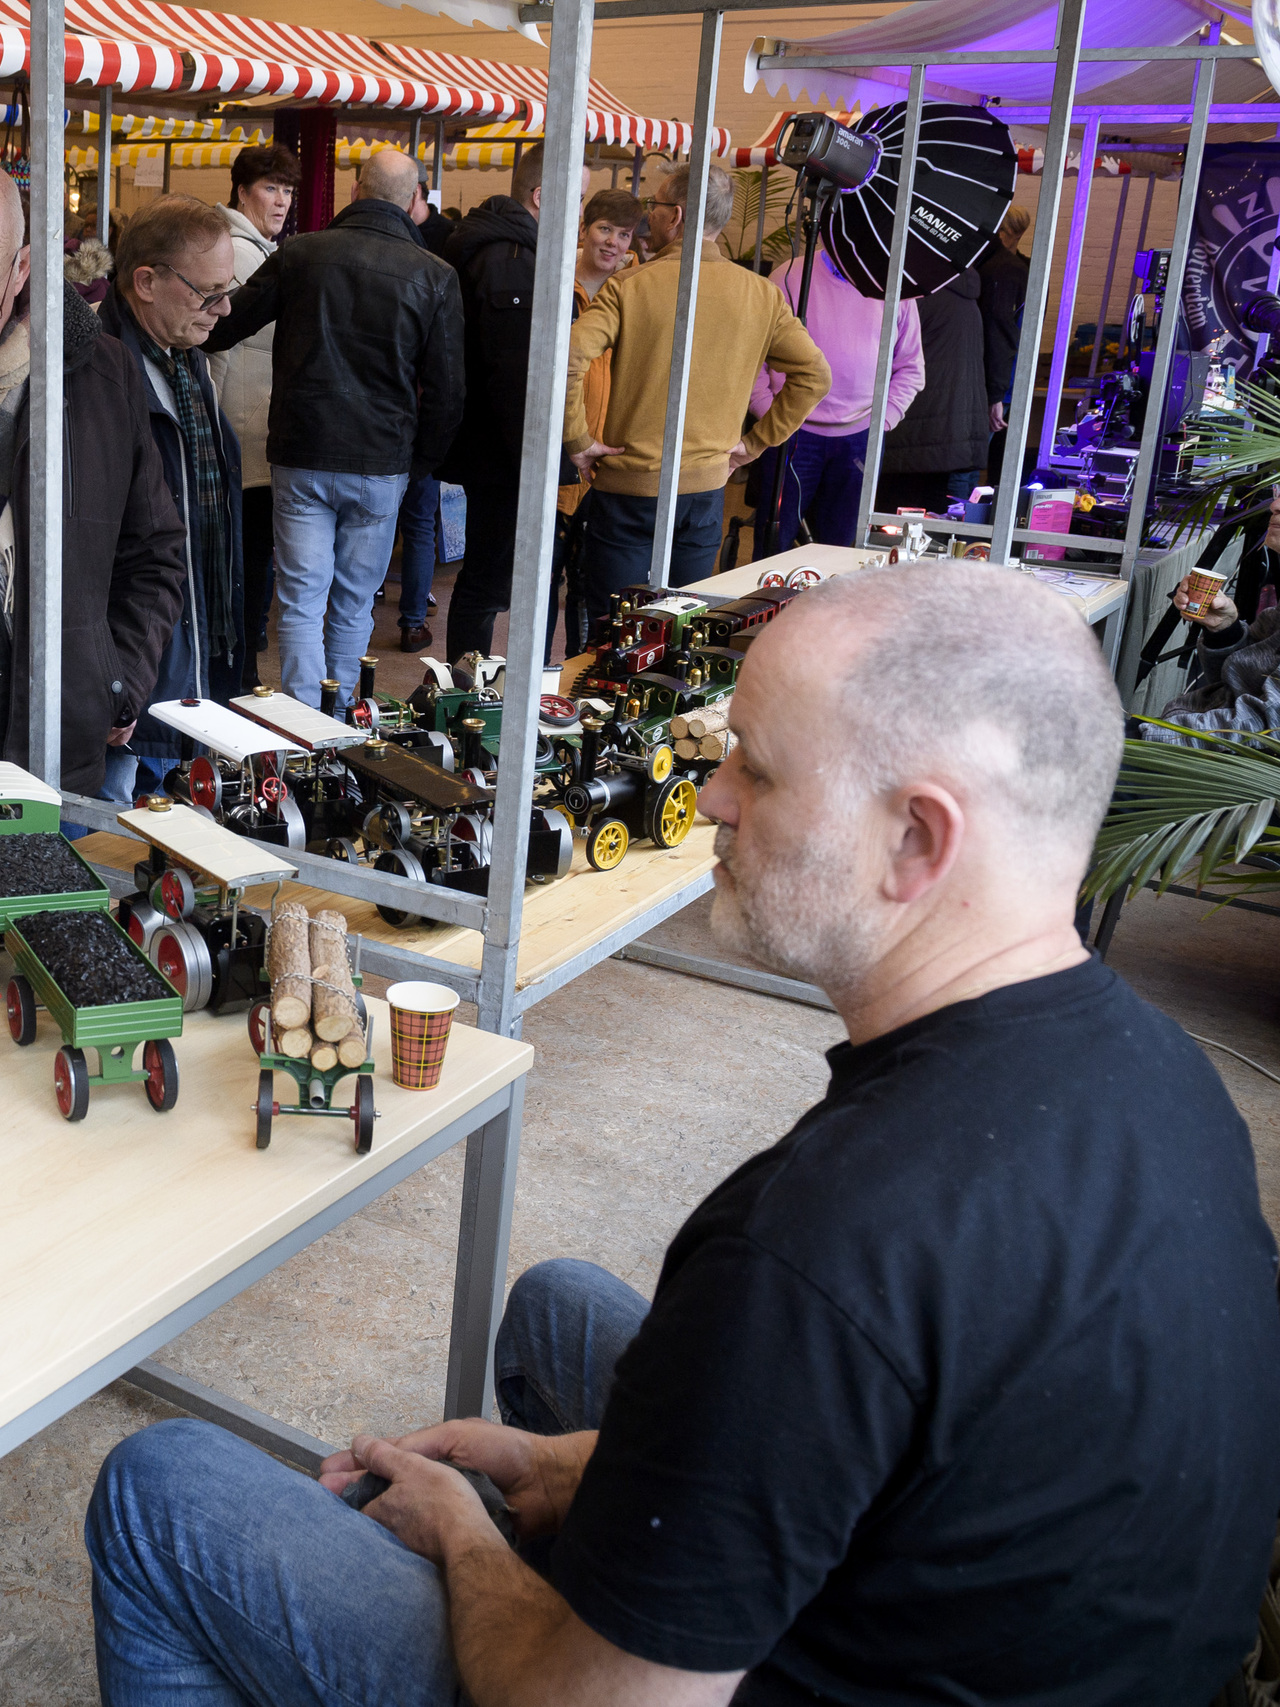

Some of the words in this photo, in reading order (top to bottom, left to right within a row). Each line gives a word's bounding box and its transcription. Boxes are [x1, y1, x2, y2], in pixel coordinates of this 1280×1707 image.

[838, 127, 864, 147] amaran
[914, 206, 962, 242] NANLITE
[1185, 239, 1220, 329] Rotterdam
